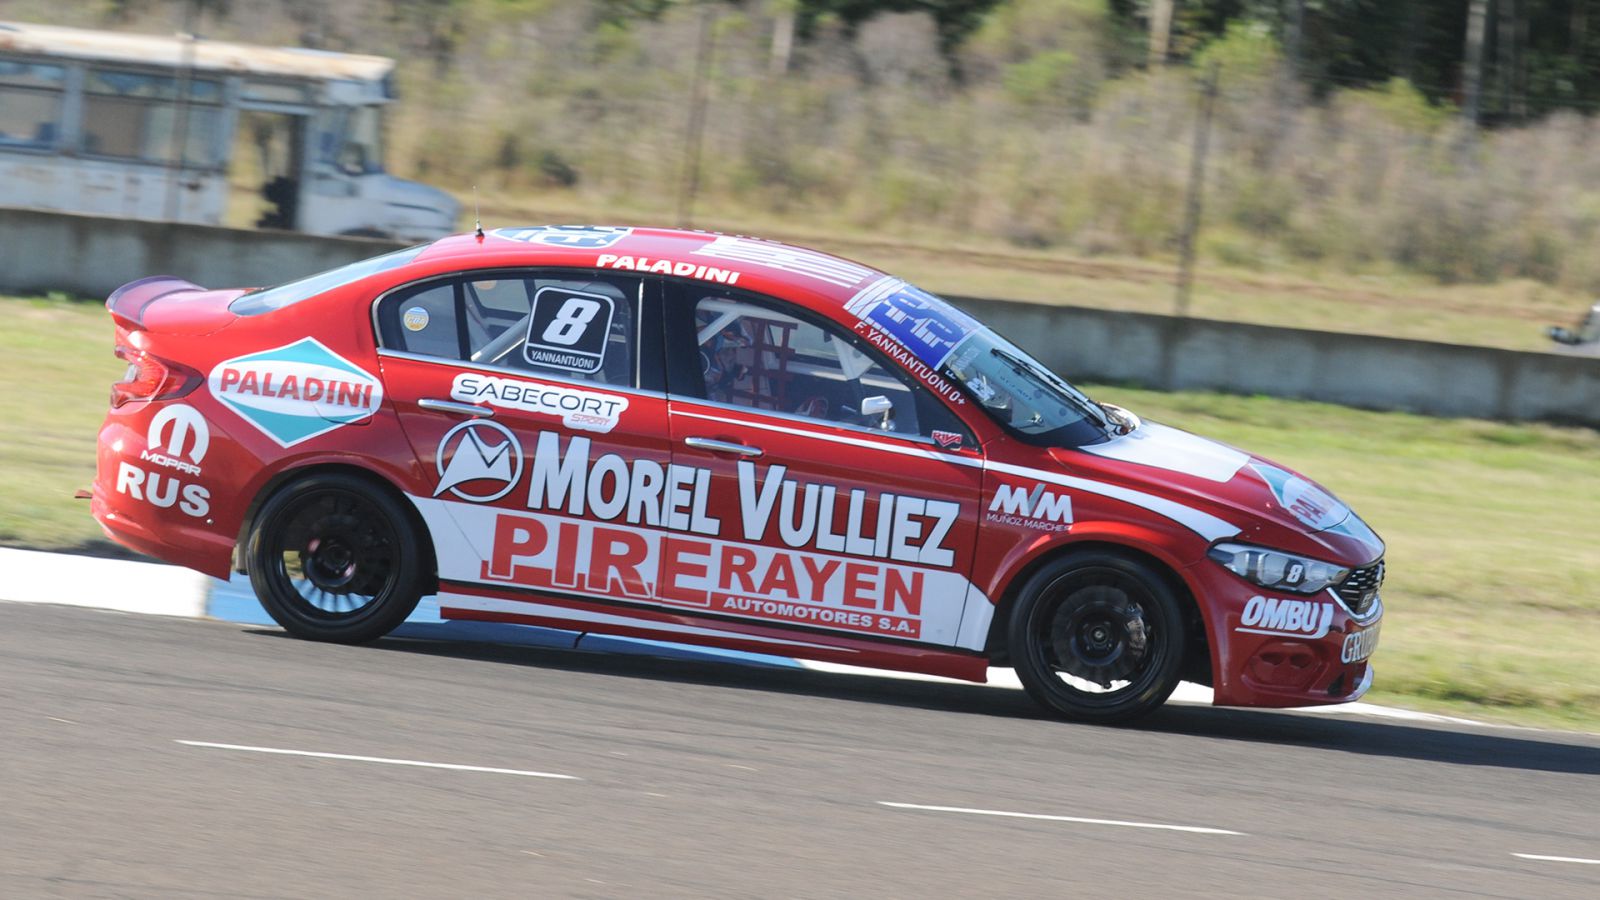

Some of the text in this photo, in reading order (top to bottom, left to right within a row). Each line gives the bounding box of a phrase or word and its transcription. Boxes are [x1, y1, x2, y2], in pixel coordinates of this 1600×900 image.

[596, 254, 743, 286] PALADINI
[541, 297, 601, 346] 8
[531, 350, 595, 370] YANNANTUONI
[866, 328, 953, 396] YANNANTUONI
[220, 367, 375, 409] PALADINI
[458, 379, 621, 417] SABECORT
[140, 450, 202, 476] MOPAR
[116, 461, 211, 518] RUS
[526, 430, 961, 568] MOREL VULLIEZ
[1285, 564, 1303, 583] 8
[723, 597, 916, 634] AUTOMOTORES S.A.
